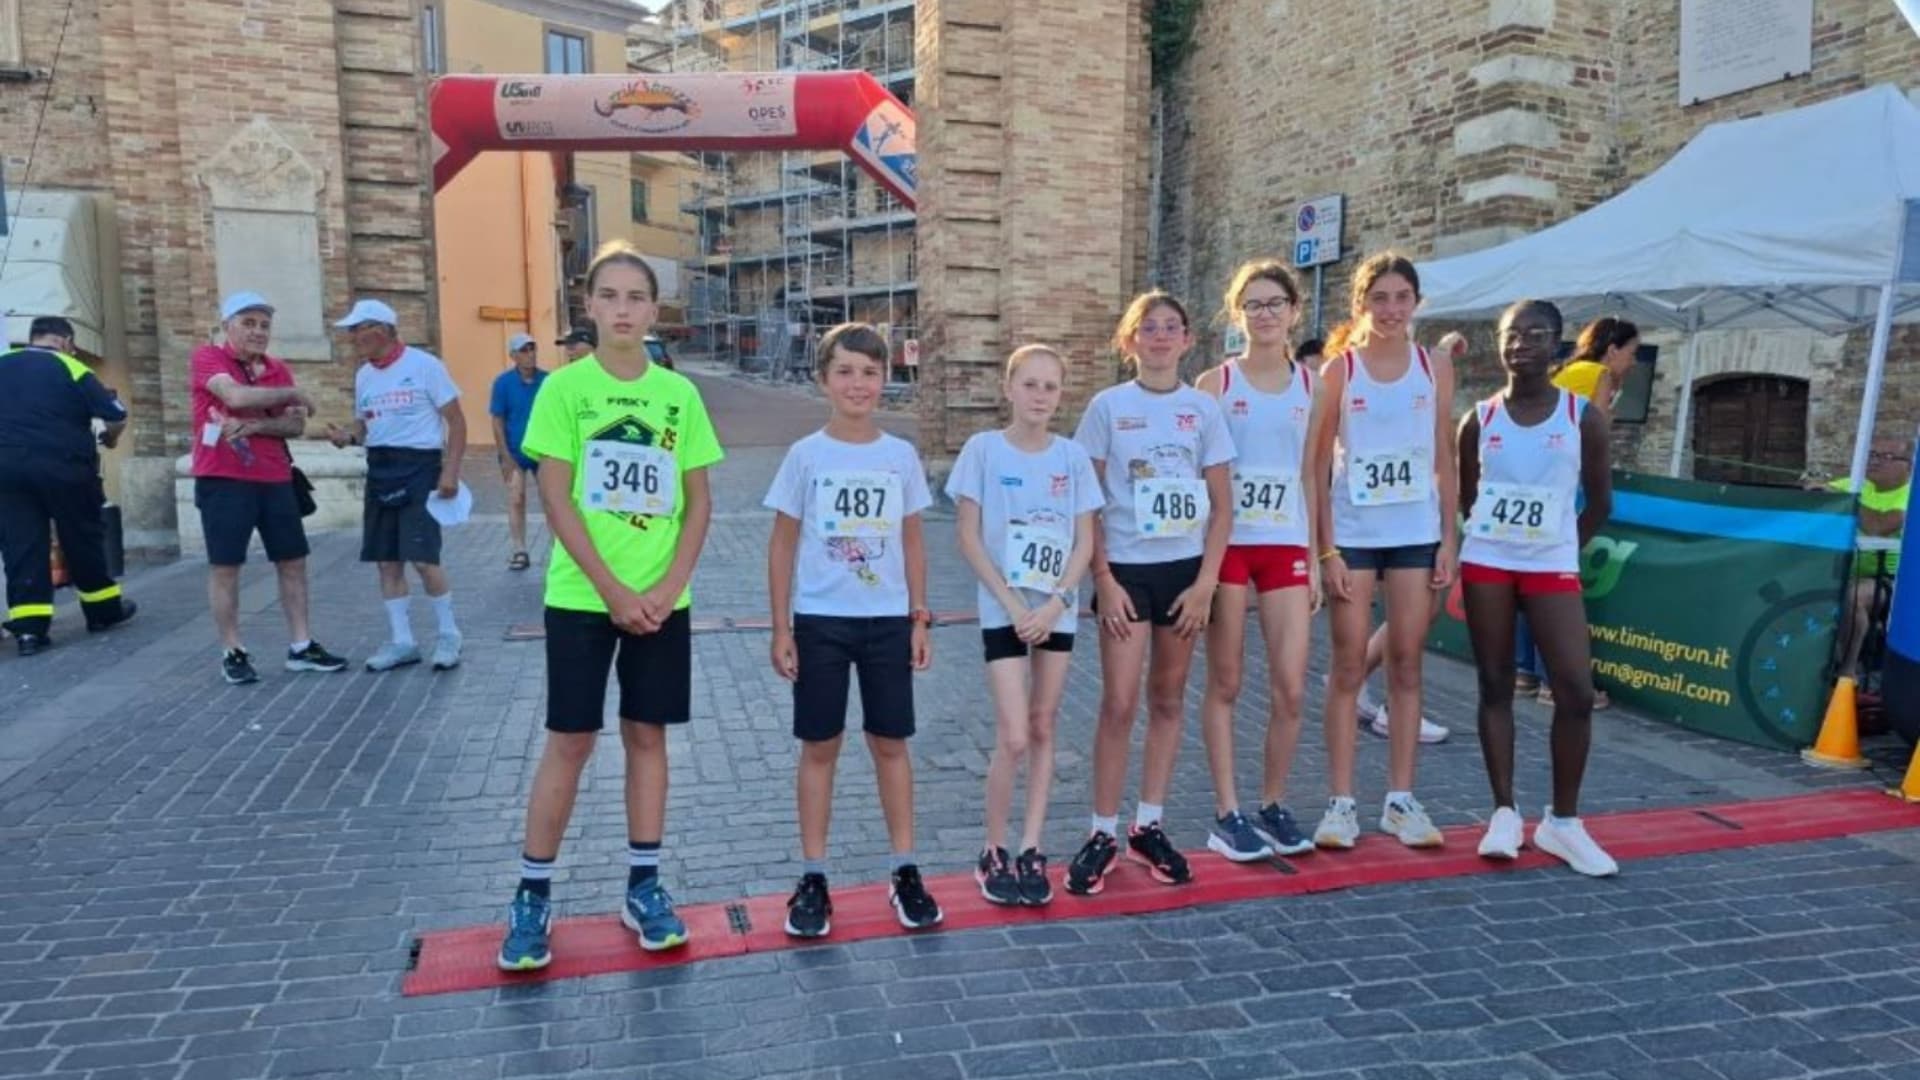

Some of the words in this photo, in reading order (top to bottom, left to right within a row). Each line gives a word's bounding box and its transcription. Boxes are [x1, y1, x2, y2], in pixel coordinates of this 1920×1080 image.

[603, 459, 658, 494] 346
[1365, 461, 1411, 489] 344
[834, 487, 886, 517] 487
[1152, 493, 1196, 520] 486
[1241, 481, 1287, 510] 347
[1491, 499, 1544, 527] 428
[1021, 542, 1063, 577] 488
